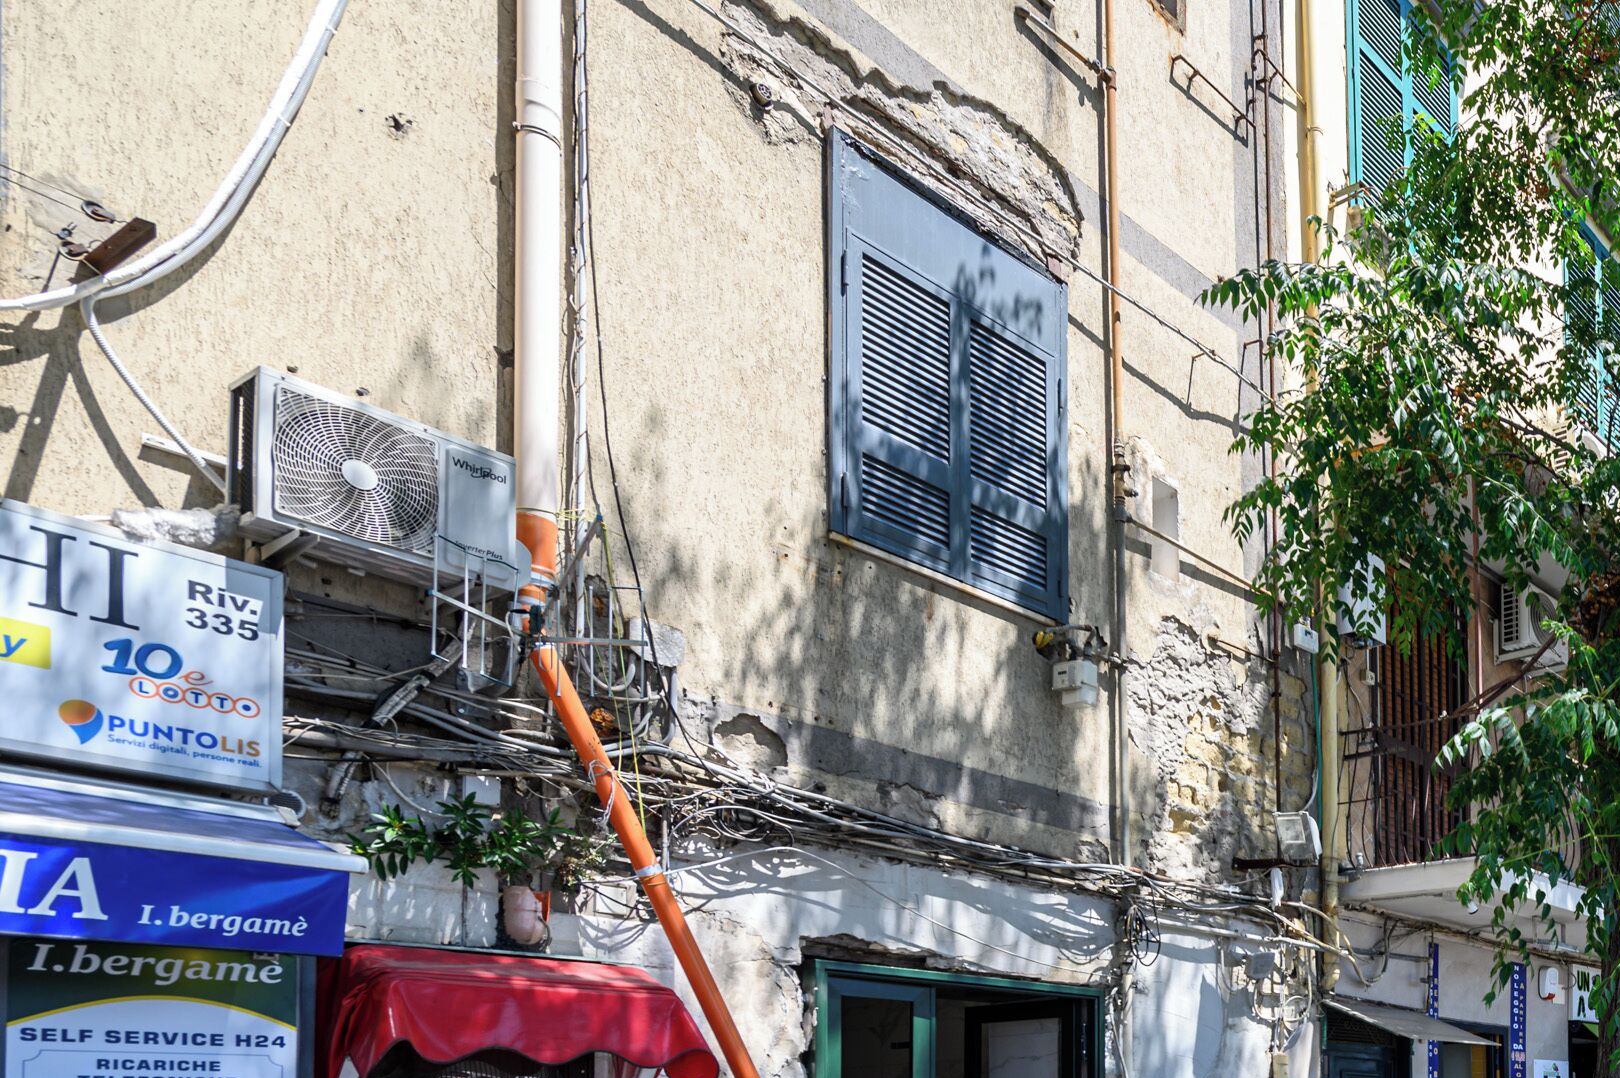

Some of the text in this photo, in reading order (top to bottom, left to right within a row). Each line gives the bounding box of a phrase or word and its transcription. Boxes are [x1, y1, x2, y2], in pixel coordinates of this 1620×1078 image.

[452, 456, 507, 484] Whirlpool
[187, 580, 258, 615] Riv.
[186, 608, 259, 641] 335
[101, 638, 183, 680] 10
[131, 677, 259, 717] LOTTO
[108, 715, 261, 757] PUNTOLIS
[108, 733, 262, 769] Servizi digitali, persone reali.
[27, 943, 283, 986] I.bergamè
[1577, 970, 1590, 992] UN
[20, 1028, 287, 1049] SELF SERVICE H24
[96, 1058, 221, 1073] RICARICHE
